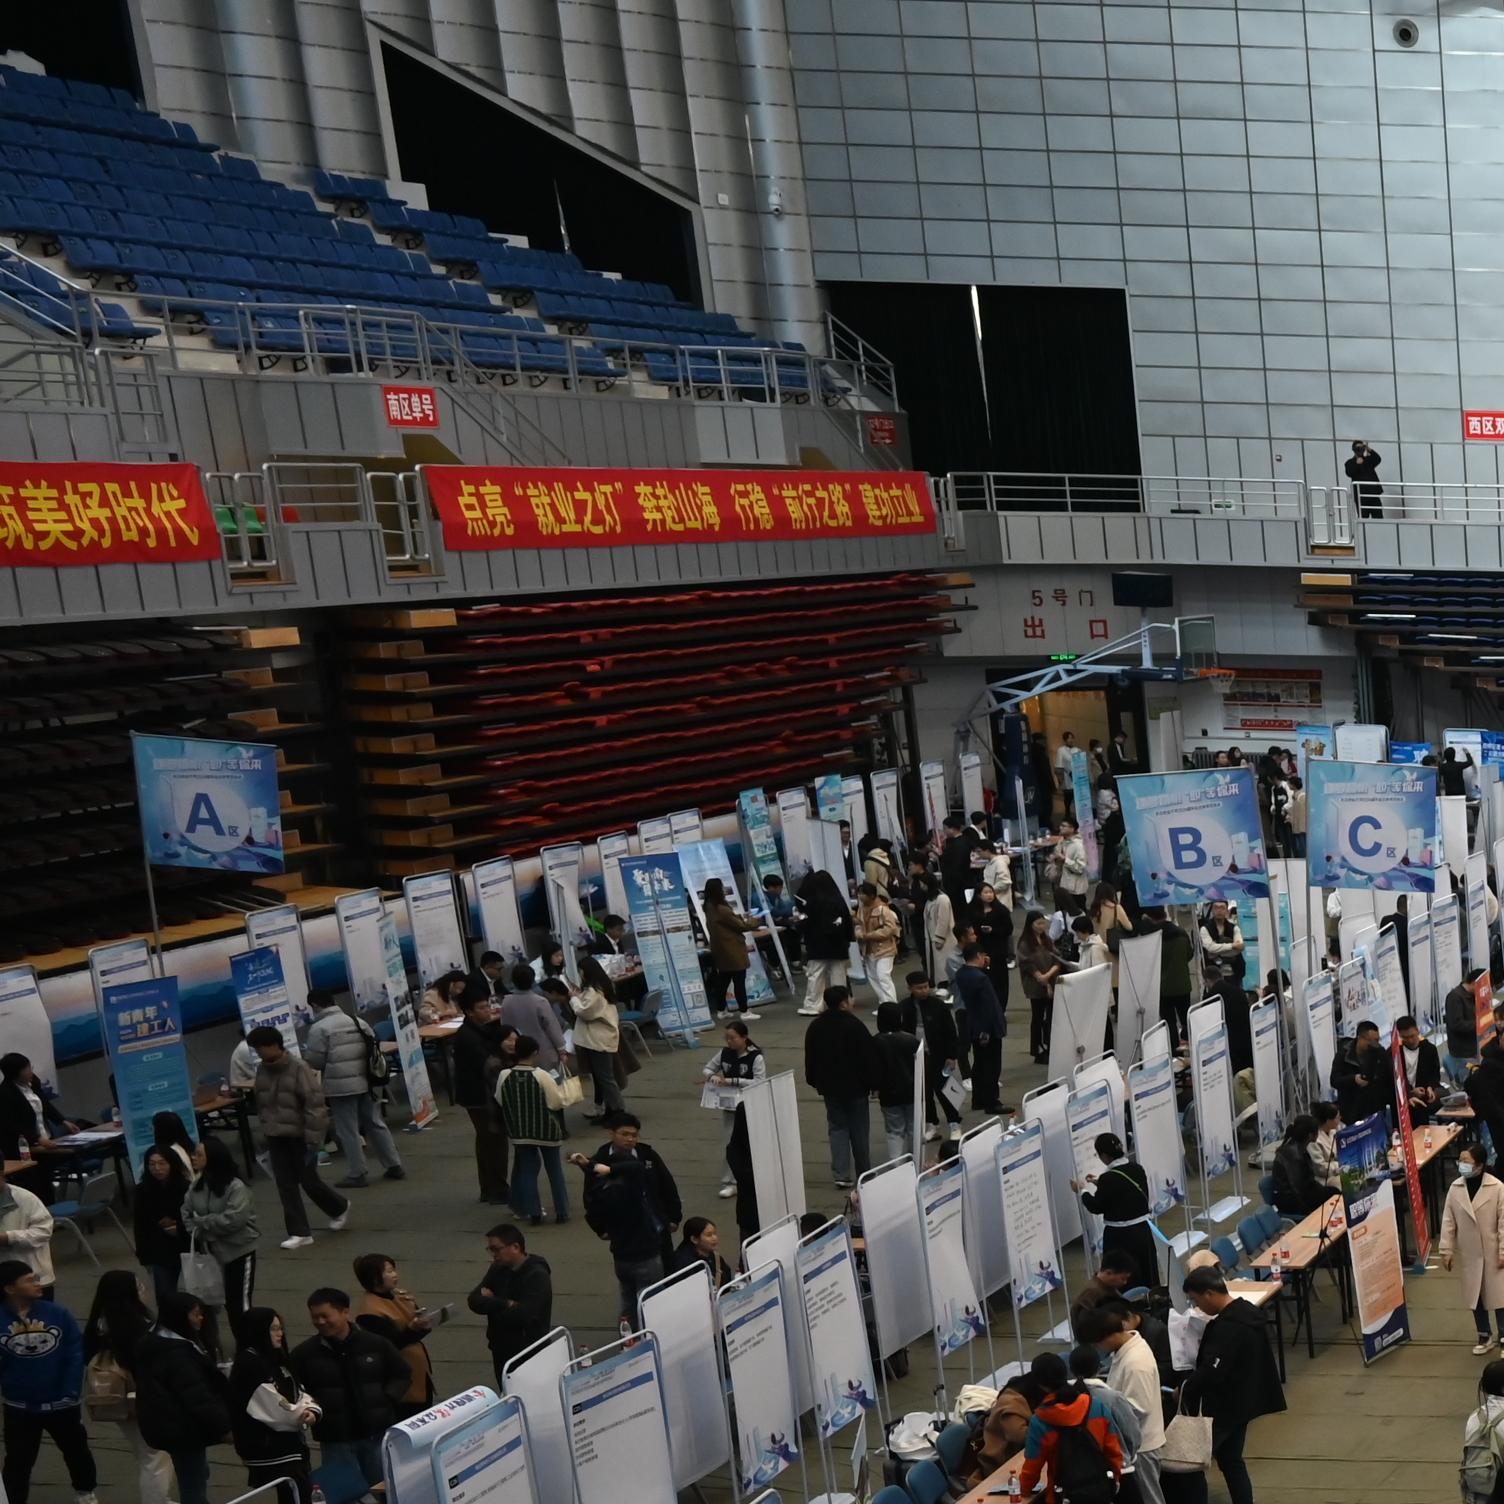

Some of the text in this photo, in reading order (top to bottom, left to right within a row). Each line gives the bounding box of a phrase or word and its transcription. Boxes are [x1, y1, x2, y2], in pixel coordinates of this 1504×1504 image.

[387, 393, 436, 422] 南区单号
[1023, 615, 1109, 640] 出口
